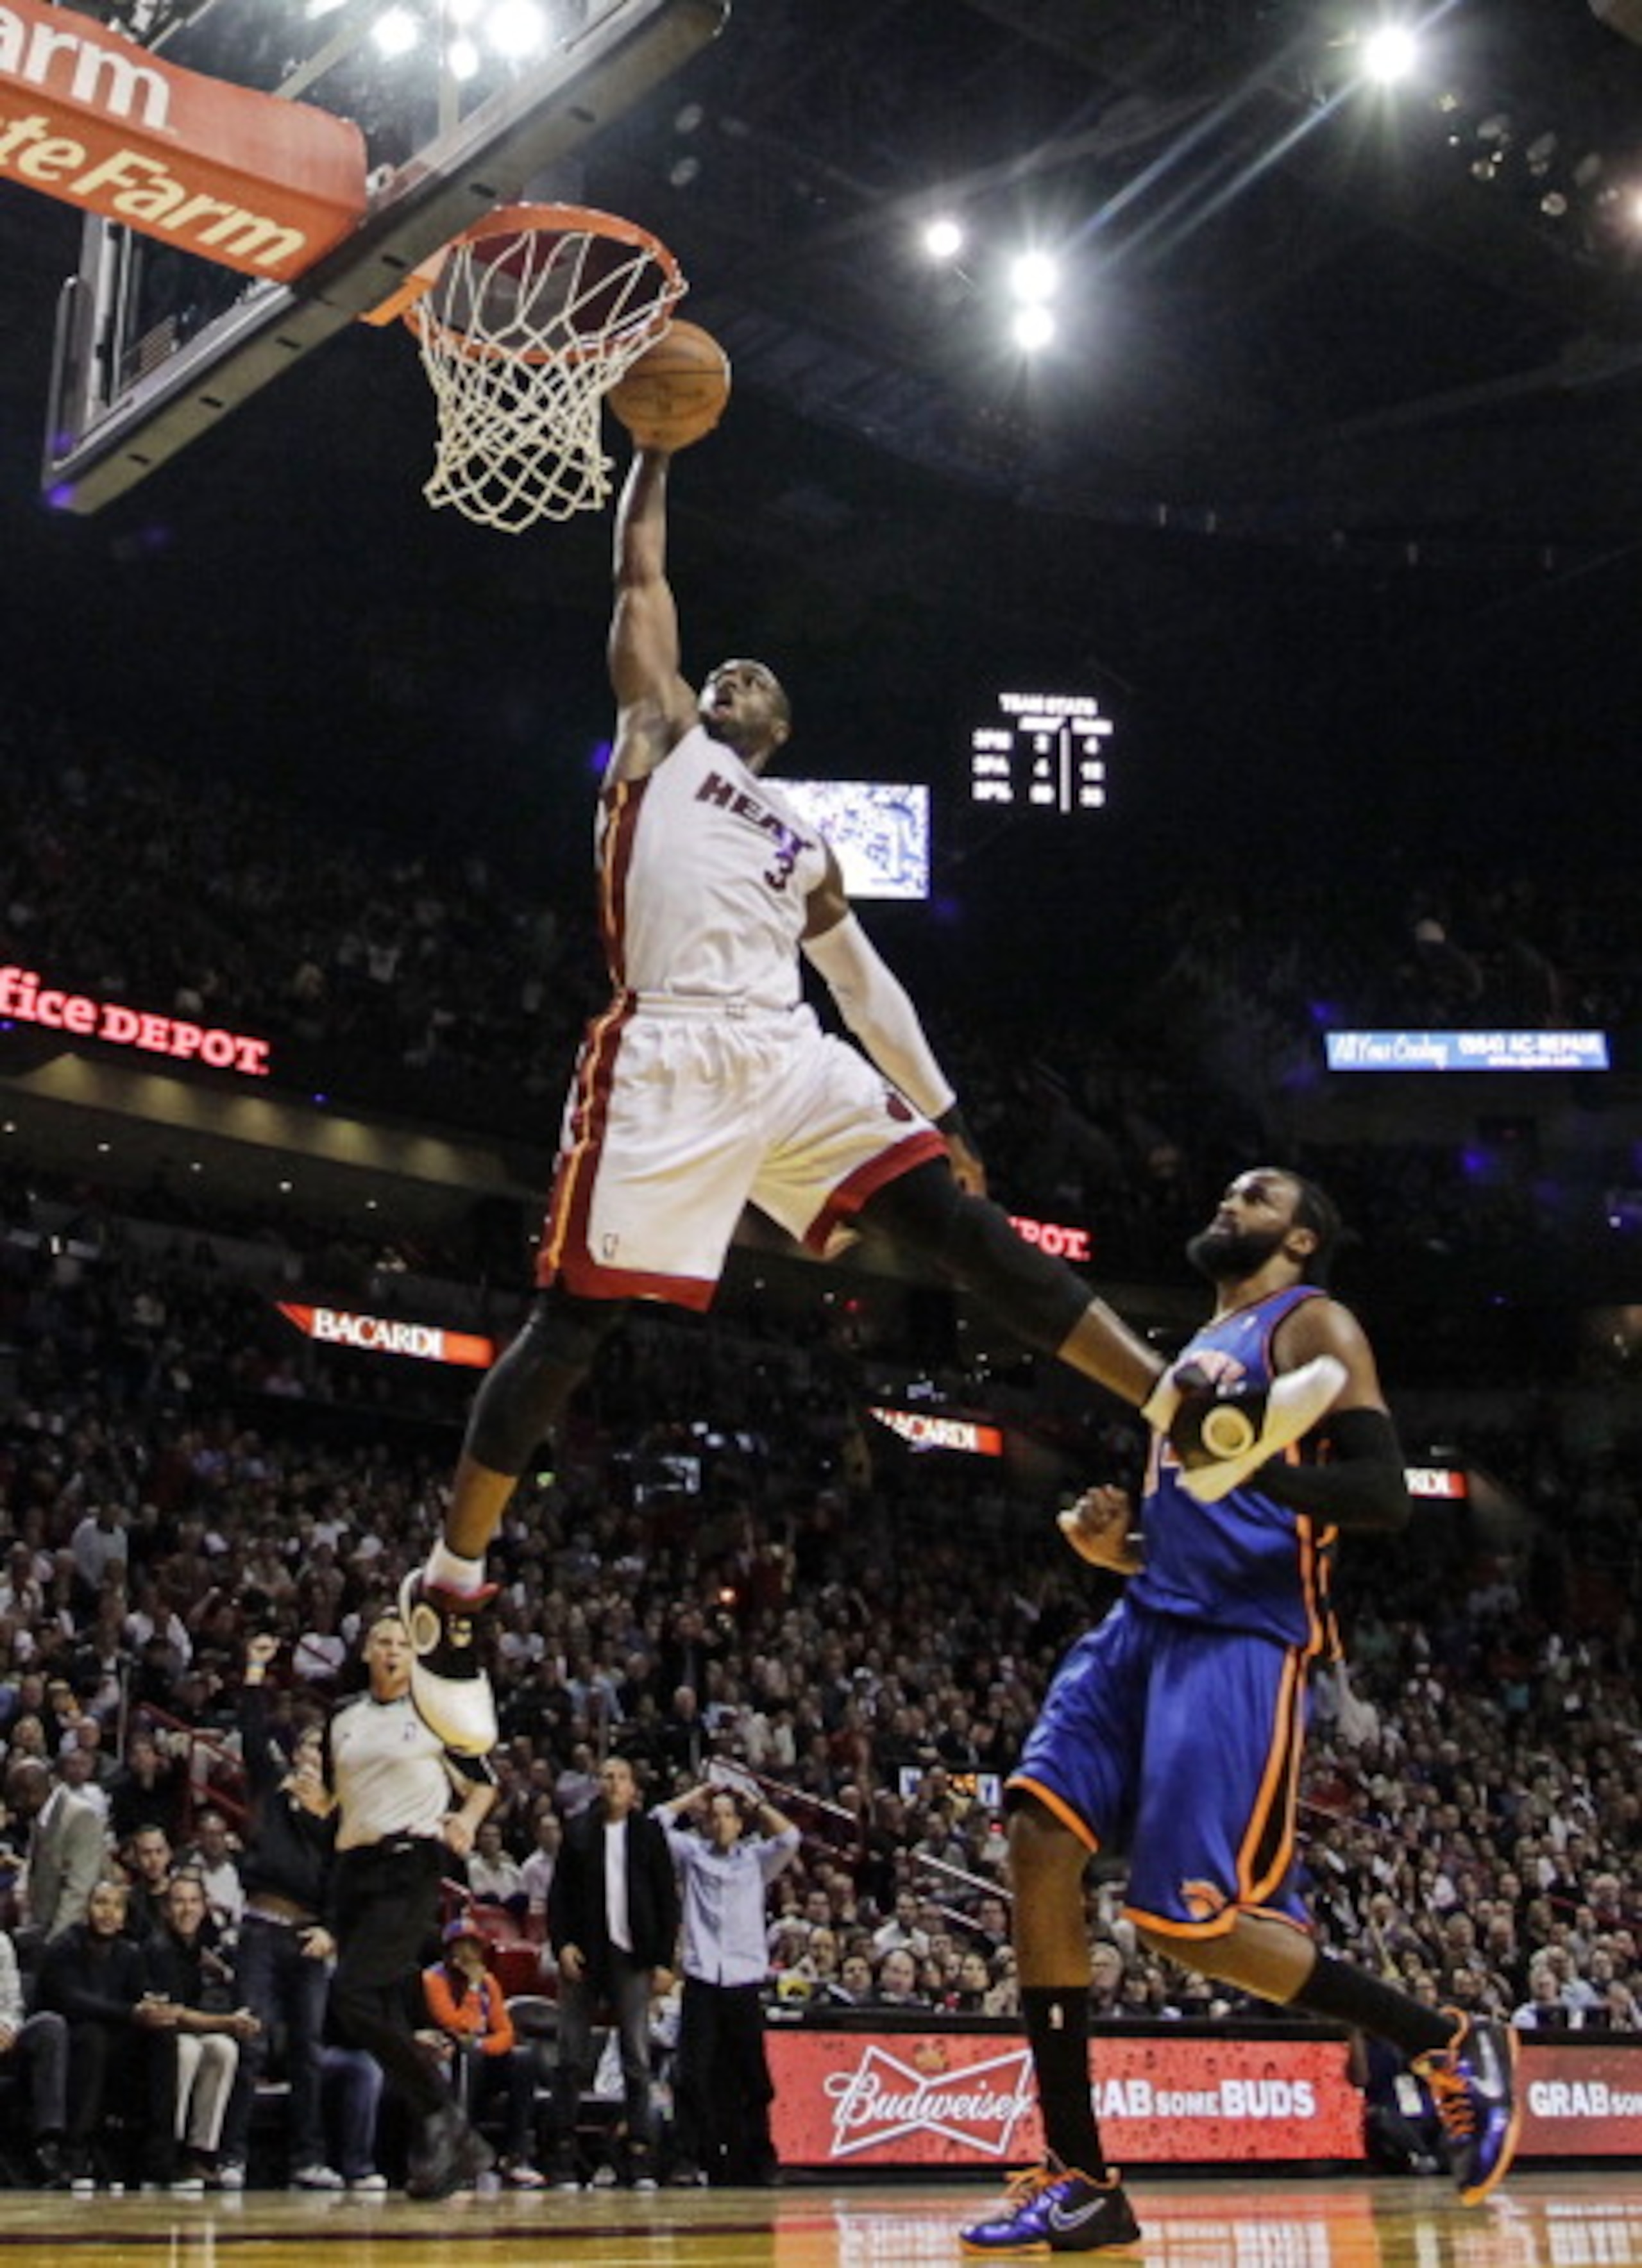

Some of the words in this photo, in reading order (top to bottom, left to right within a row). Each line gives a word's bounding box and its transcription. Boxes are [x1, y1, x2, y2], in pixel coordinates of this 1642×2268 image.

[69, 149, 306, 266] Farm
[695, 770, 817, 858] HEAT
[763, 850, 795, 893] 3
[310, 1307, 445, 1360] BACARDI
[824, 2070, 1034, 2128] Budweiser
[1155, 2090, 1219, 2117] SOME
[1221, 2079, 1316, 2120] BUDS
[1528, 2079, 1609, 2117] GRAB
